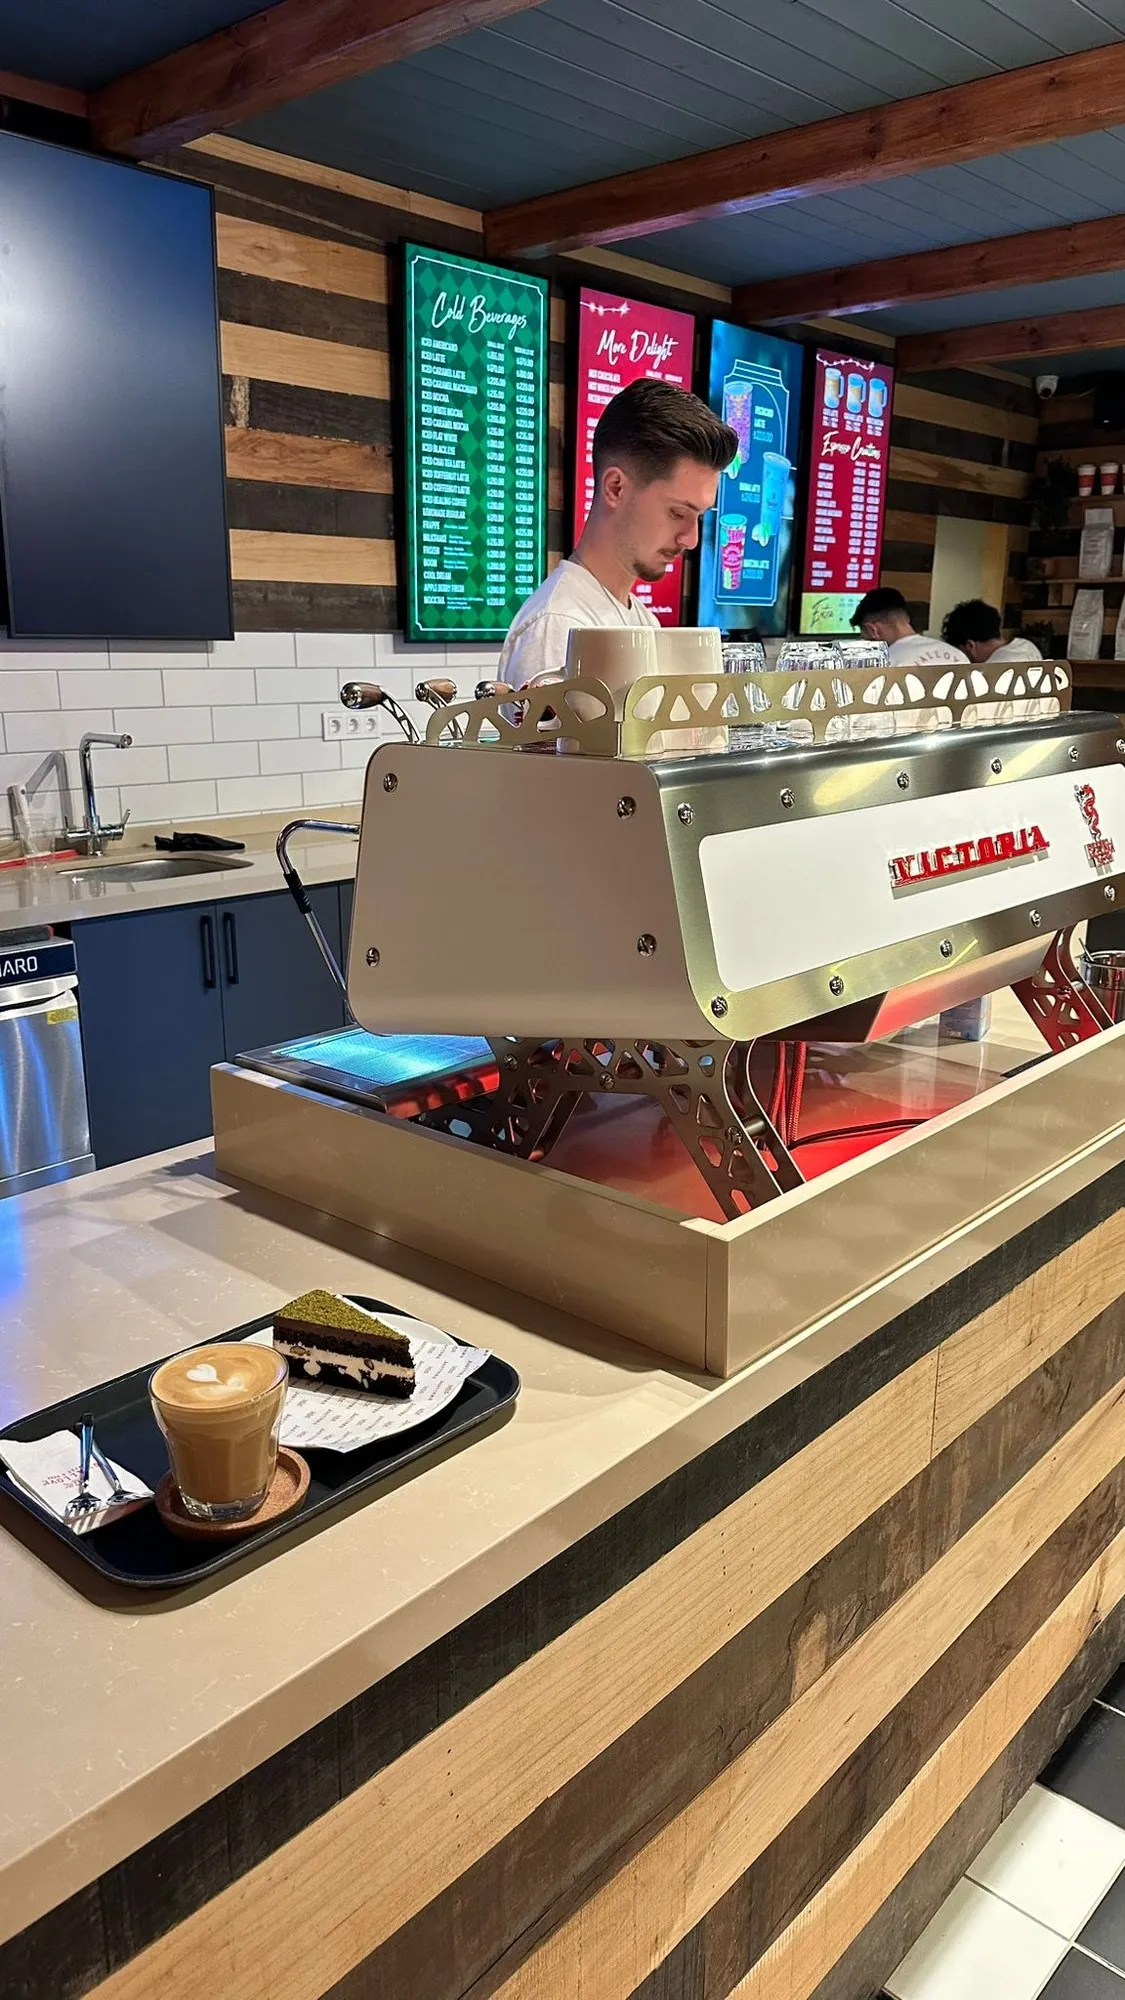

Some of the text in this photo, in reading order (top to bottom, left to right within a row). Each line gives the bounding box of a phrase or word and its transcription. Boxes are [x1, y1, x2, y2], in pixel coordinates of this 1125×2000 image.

[432, 291, 527, 340] Cold Beverages
[596, 329, 679, 370] More Delight
[891, 825, 1050, 888] VICTORIA
[0, 956, 38, 978] ARO
